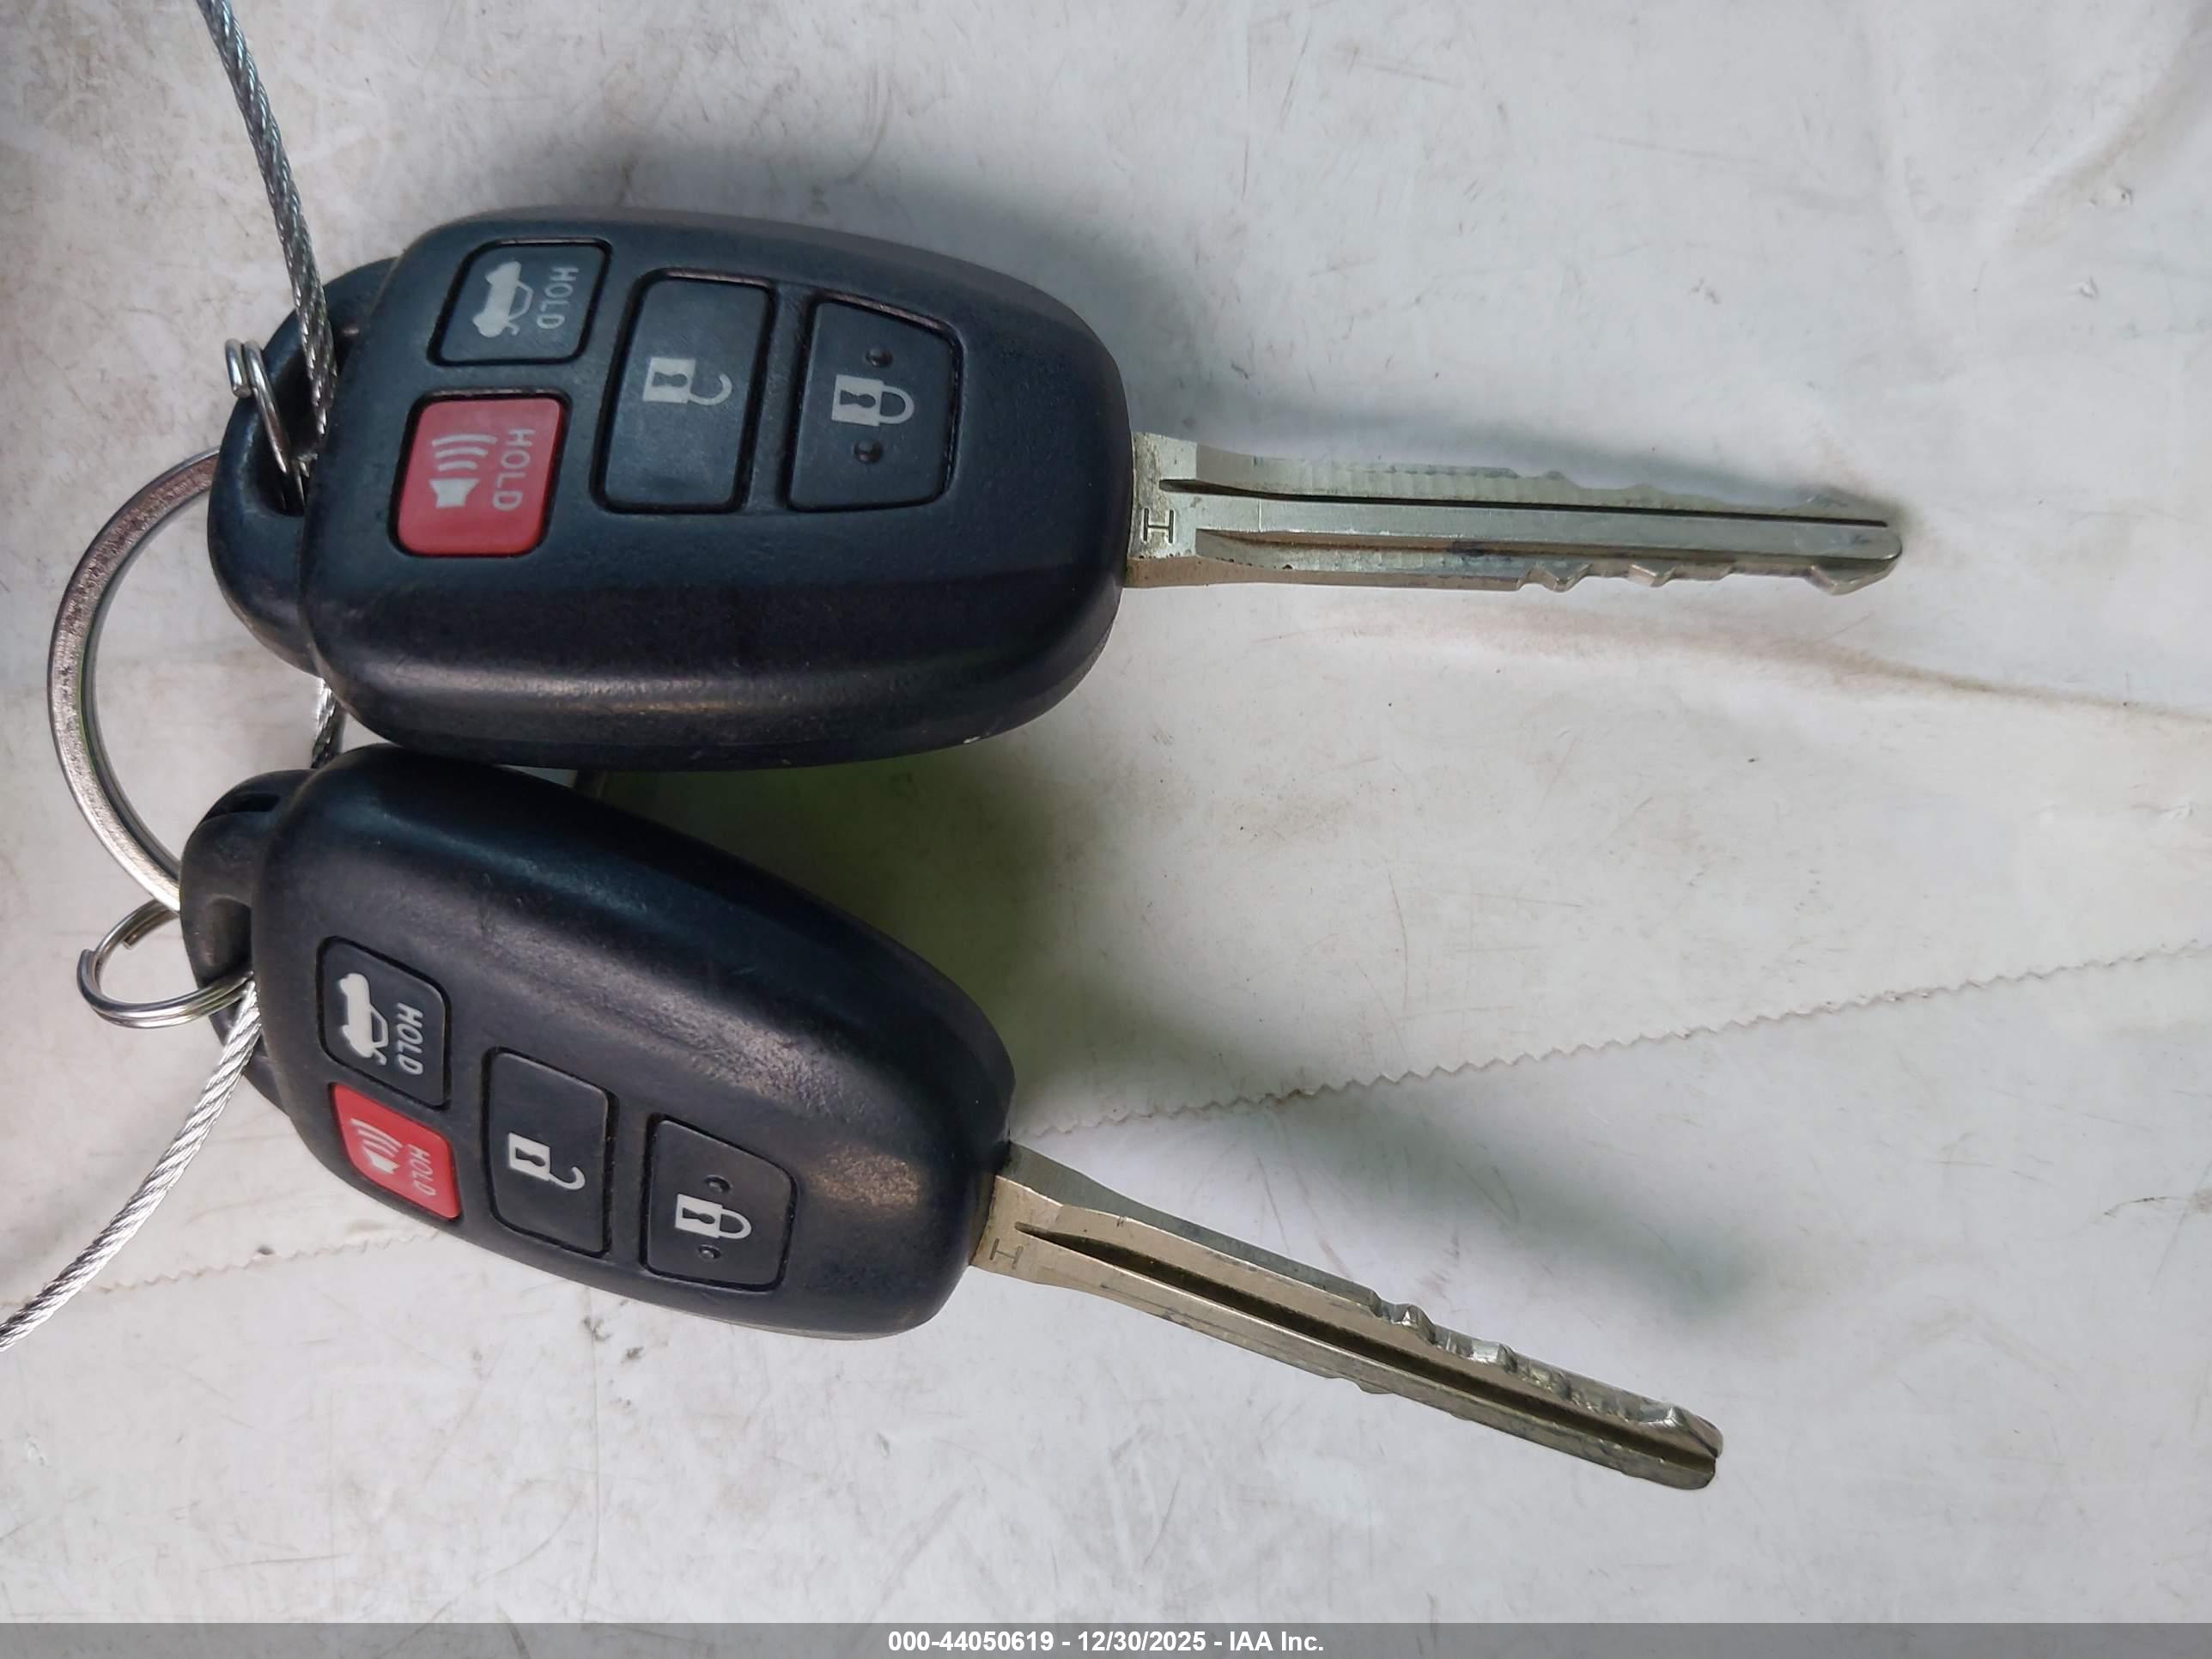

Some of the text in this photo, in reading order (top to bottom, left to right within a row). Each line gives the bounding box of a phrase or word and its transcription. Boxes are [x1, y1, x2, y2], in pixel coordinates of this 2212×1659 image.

[536, 266, 580, 330] HOLD
[492, 428, 537, 511] HOLD
[1143, 507, 1175, 544] H
[397, 1002, 424, 1075] HOLD
[407, 1144, 436, 1196] HOLD
[989, 1237, 1024, 1269] H
